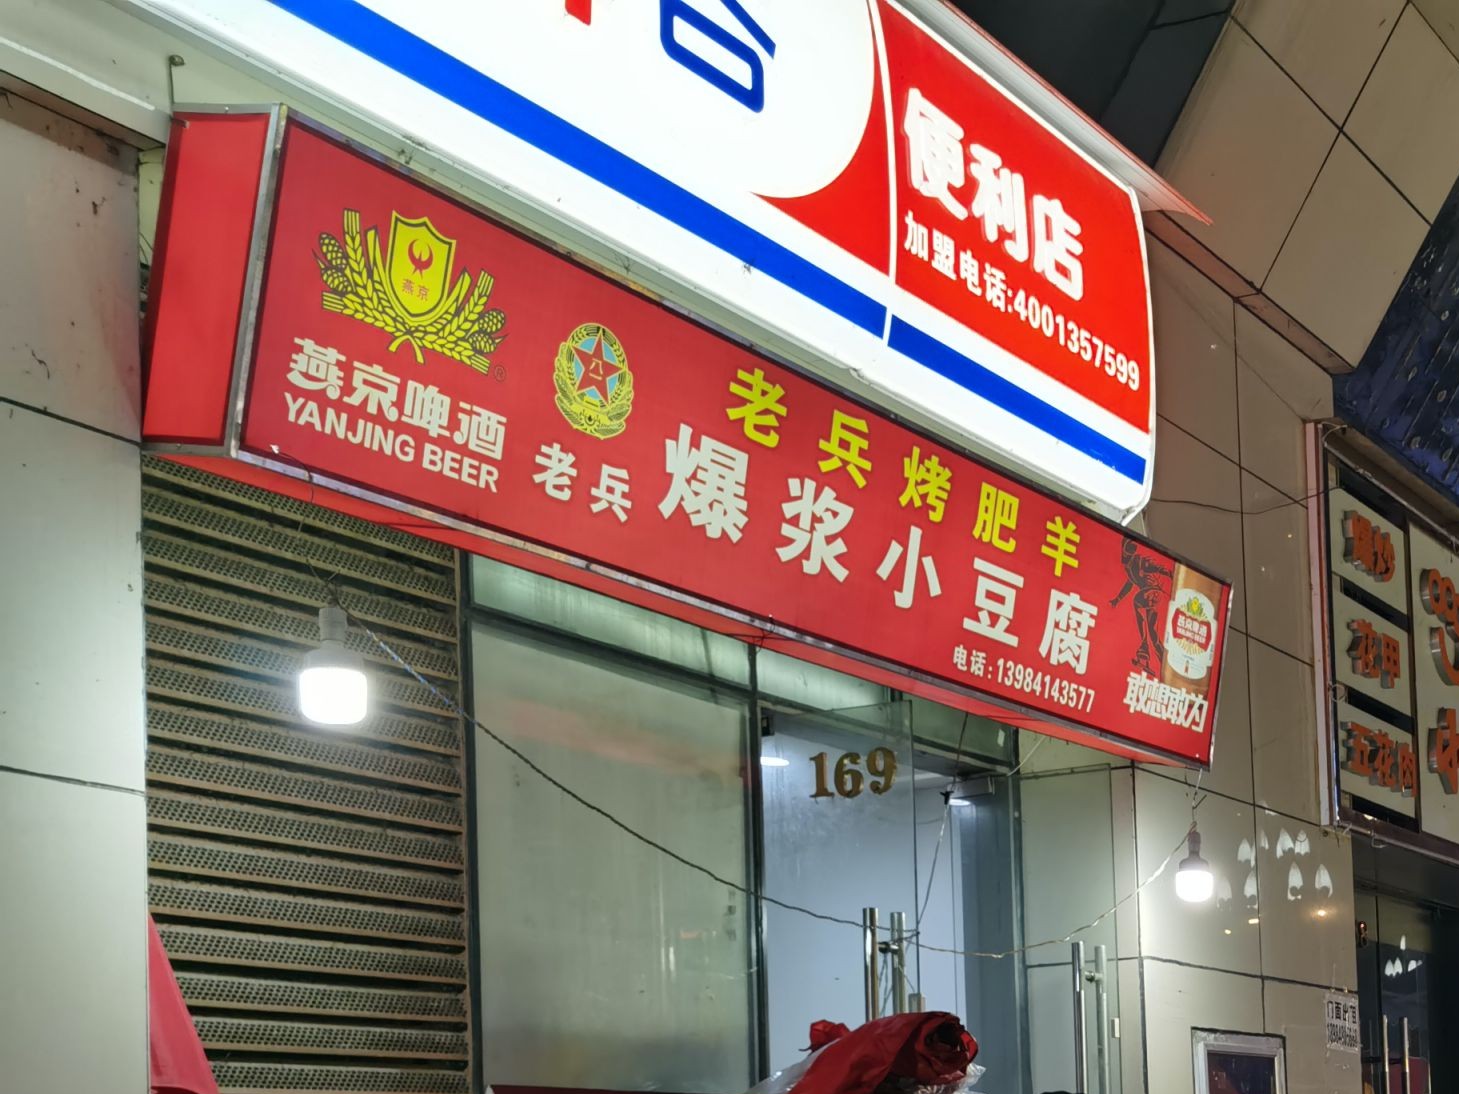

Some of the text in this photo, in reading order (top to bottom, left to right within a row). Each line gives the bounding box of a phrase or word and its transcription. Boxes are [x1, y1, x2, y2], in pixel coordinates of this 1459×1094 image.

[903, 88, 1084, 301] 便利店
[402, 278, 429, 300] 燕京
[904, 210, 1140, 391] 加盟电话:4001357599
[284, 392, 499, 493] YANJING BEER
[286, 337, 507, 461] 燕京啤酒
[533, 442, 633, 522] 老兵
[726, 368, 1081, 577] 老兵烤肥羊
[658, 423, 1098, 675] 爆浆小豆腐
[1349, 618, 1401, 688] 花甲
[1123, 671, 1209, 733] 敢想敢为
[808, 746, 897, 799] 169
[1342, 721, 1417, 797] 五花肉
